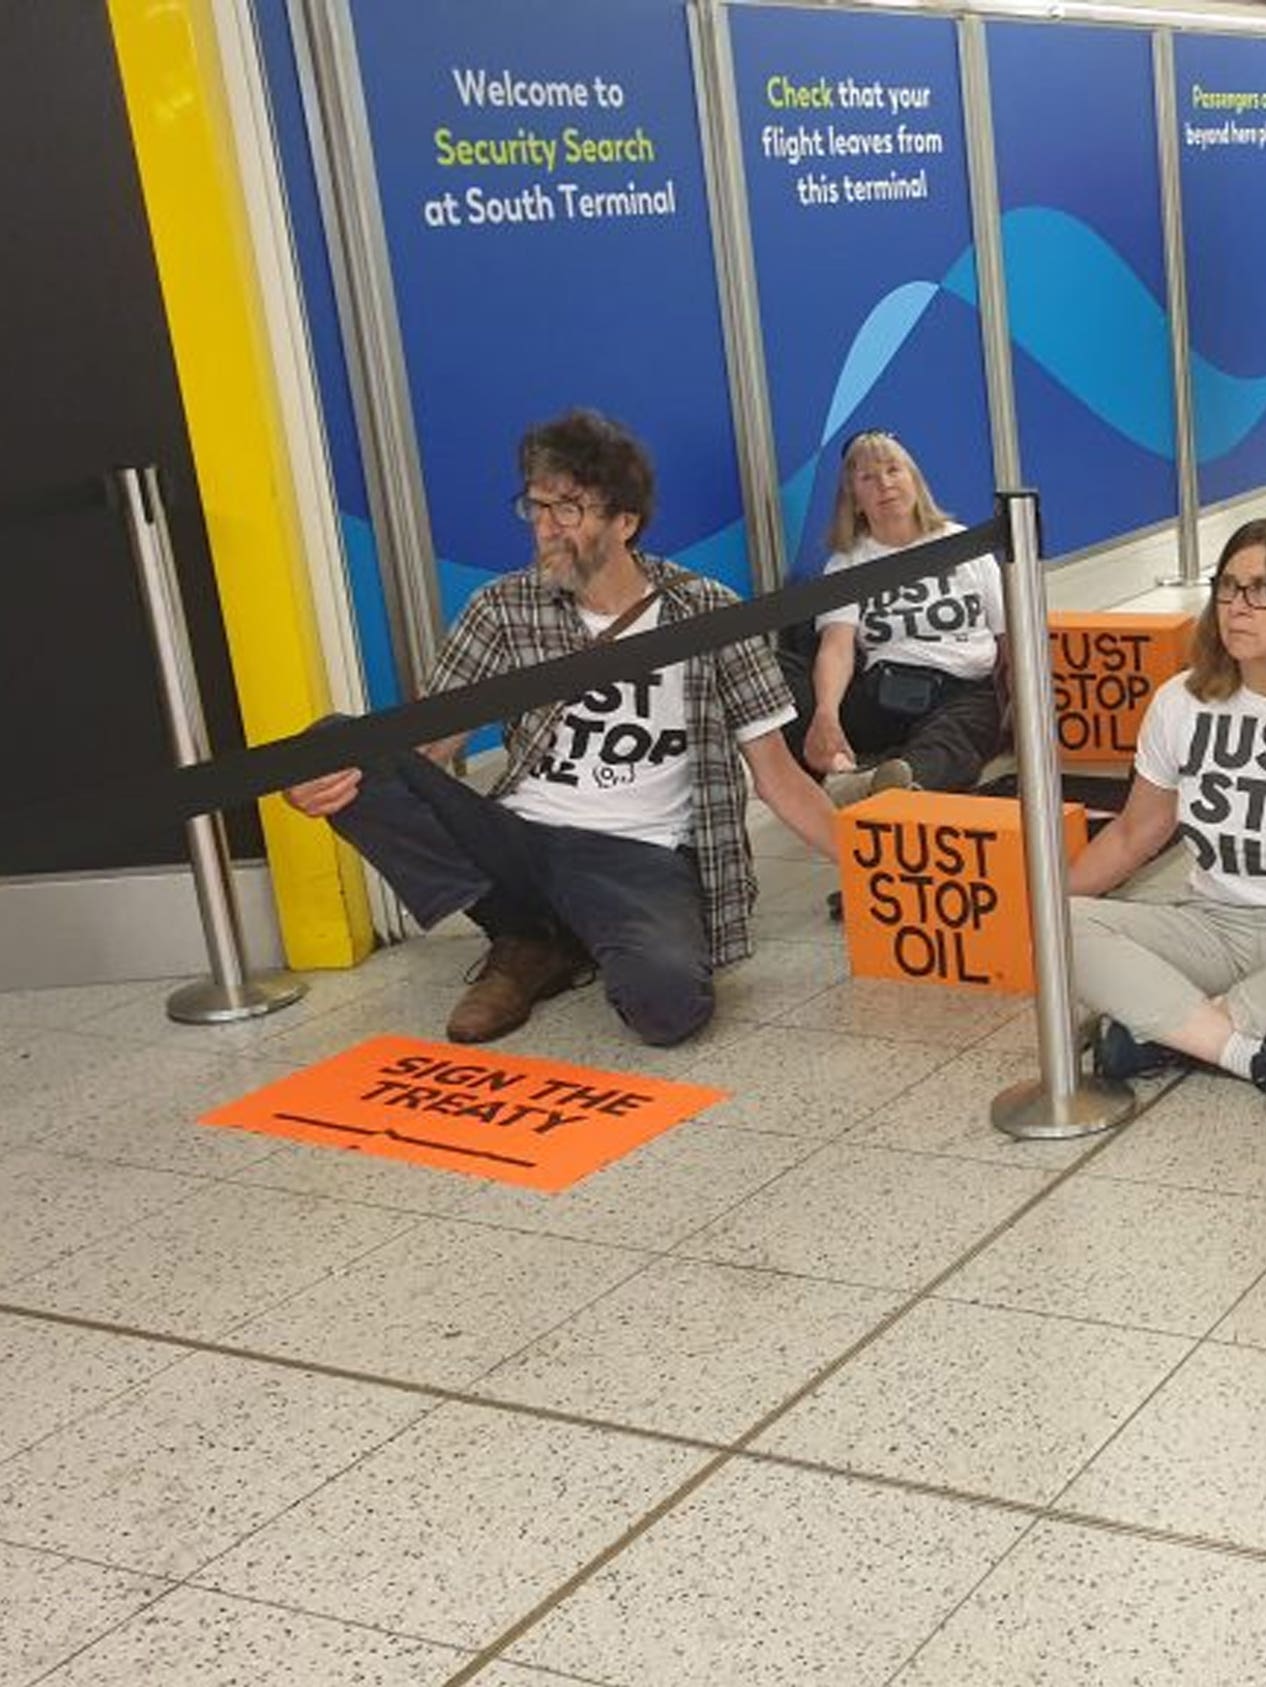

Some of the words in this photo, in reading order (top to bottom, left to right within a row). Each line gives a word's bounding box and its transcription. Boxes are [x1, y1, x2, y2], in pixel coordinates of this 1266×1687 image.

[453, 69, 588, 108] Welcome
[595, 75, 624, 107] to
[767, 76, 834, 109] Check
[839, 77, 884, 110] that
[889, 87, 931, 114] your
[435, 129, 556, 171] Security
[563, 128, 655, 162] Search
[762, 126, 825, 164] flight
[829, 128, 893, 157] leaves
[898, 125, 943, 155] from
[425, 194, 459, 227] at
[467, 187, 554, 224] South
[559, 180, 676, 218] Terminal
[798, 176, 839, 206] this
[844, 170, 927, 203] terminal
[864, 594, 980, 643] STOP
[1049, 632, 1150, 672] UST
[563, 712, 688, 765] TOP
[1057, 711, 1138, 751] OIL
[853, 820, 998, 878] JUST
[869, 871, 998, 931] STOP
[894, 925, 990, 984] OIL
[360, 1080, 590, 1135] TREATY
[381, 1055, 527, 1092] SIGN
[533, 1078, 655, 1117] THE
